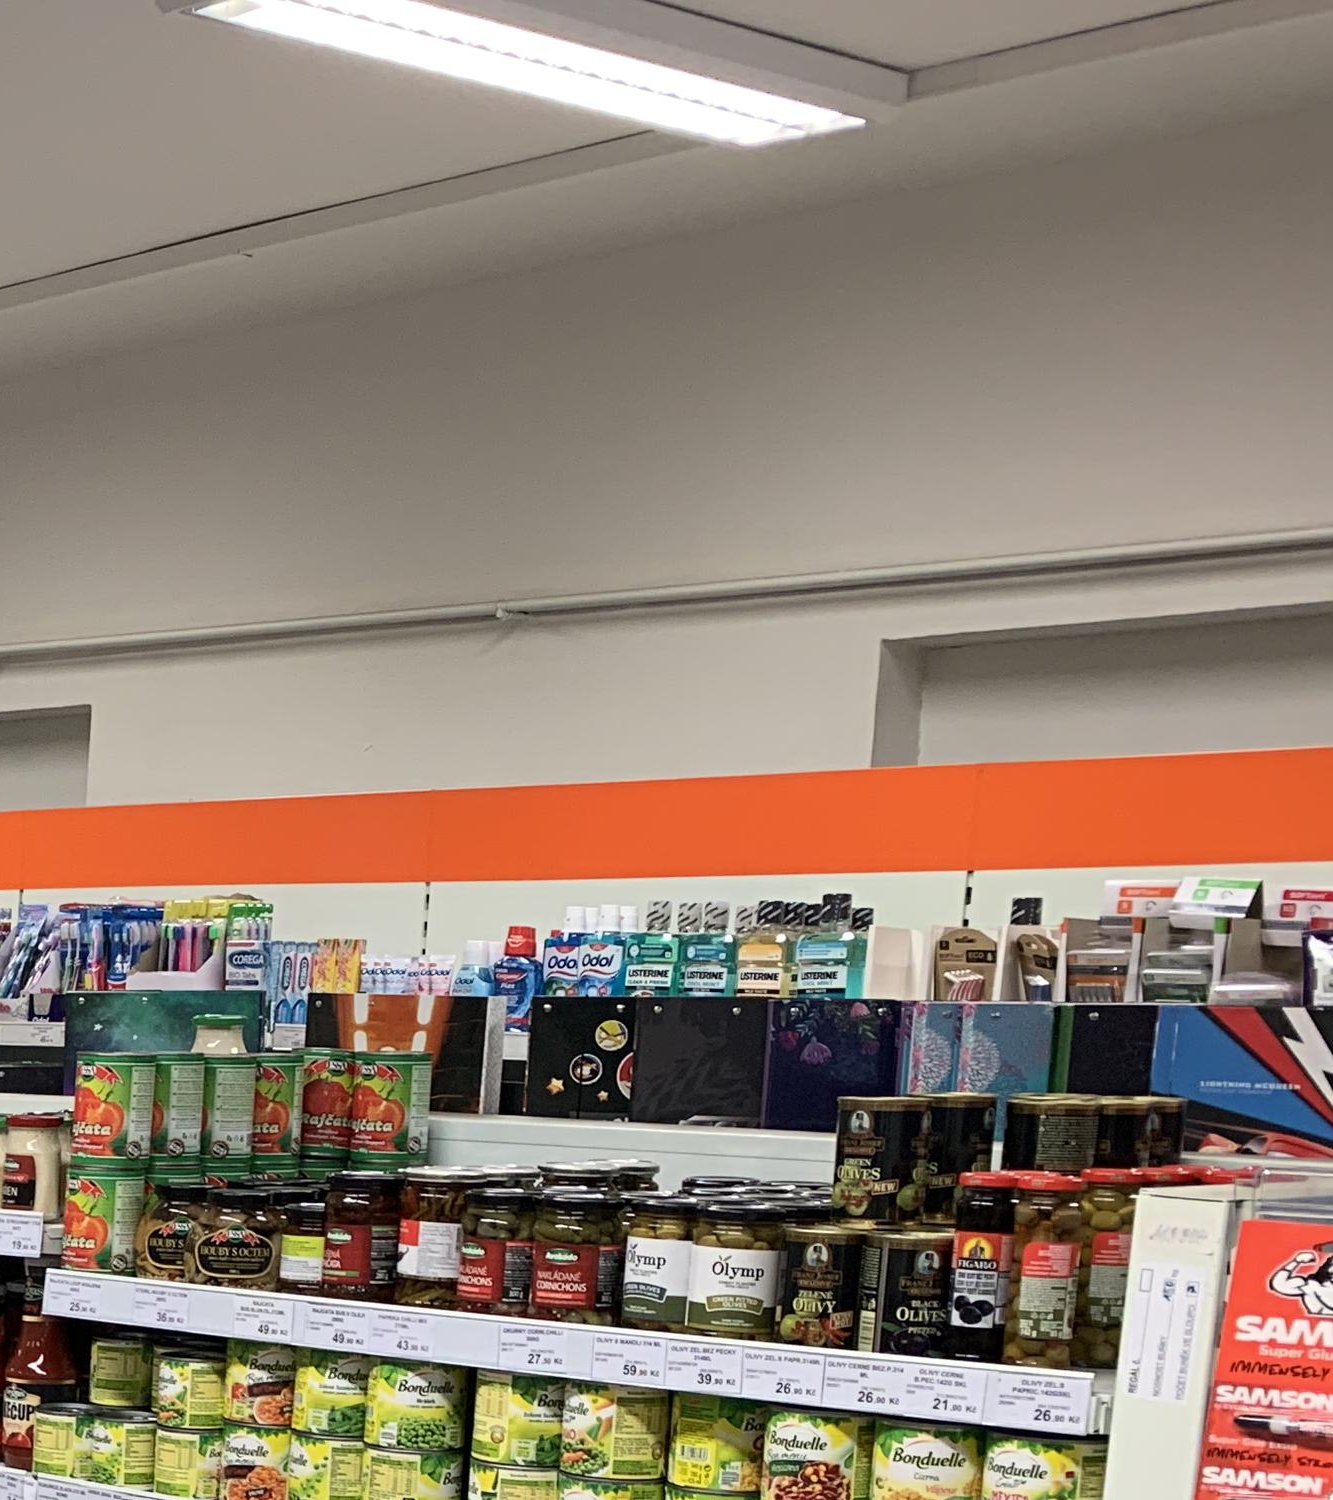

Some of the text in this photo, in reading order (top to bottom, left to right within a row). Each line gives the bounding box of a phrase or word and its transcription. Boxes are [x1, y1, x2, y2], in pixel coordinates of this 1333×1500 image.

[582, 952, 615, 968] Odol
[628, 969, 670, 979] LISTERINE
[686, 971, 725, 981] LISTERINE
[740, 972, 779, 982] LISTERINE
[801, 970, 839, 980] LISTERINE
[843, 1157, 871, 1168] GREEN
[837, 1165, 882, 1181] OLIVES
[872, 1182, 899, 1194] NEW
[711, 1256, 765, 1282] Olymp
[535, 1279, 588, 1293] CORNICHONS
[792, 1299, 836, 1314] OLIVY
[895, 1306, 948, 1322] OLIVES
[1258, 1344, 1304, 1359] Super
[1230, 1360, 1332, 1379] IMMENSELY
[398, 1379, 455, 1397] Bonduelle
[769, 1431, 828, 1452] Bonduelle
[892, 1447, 967, 1470] Bonduelle
[1206, 1447, 1292, 1466] IMMENSELY
[988, 1456, 1049, 1482] Bonduelle
[1201, 1465, 1325, 1496] SAMSON
